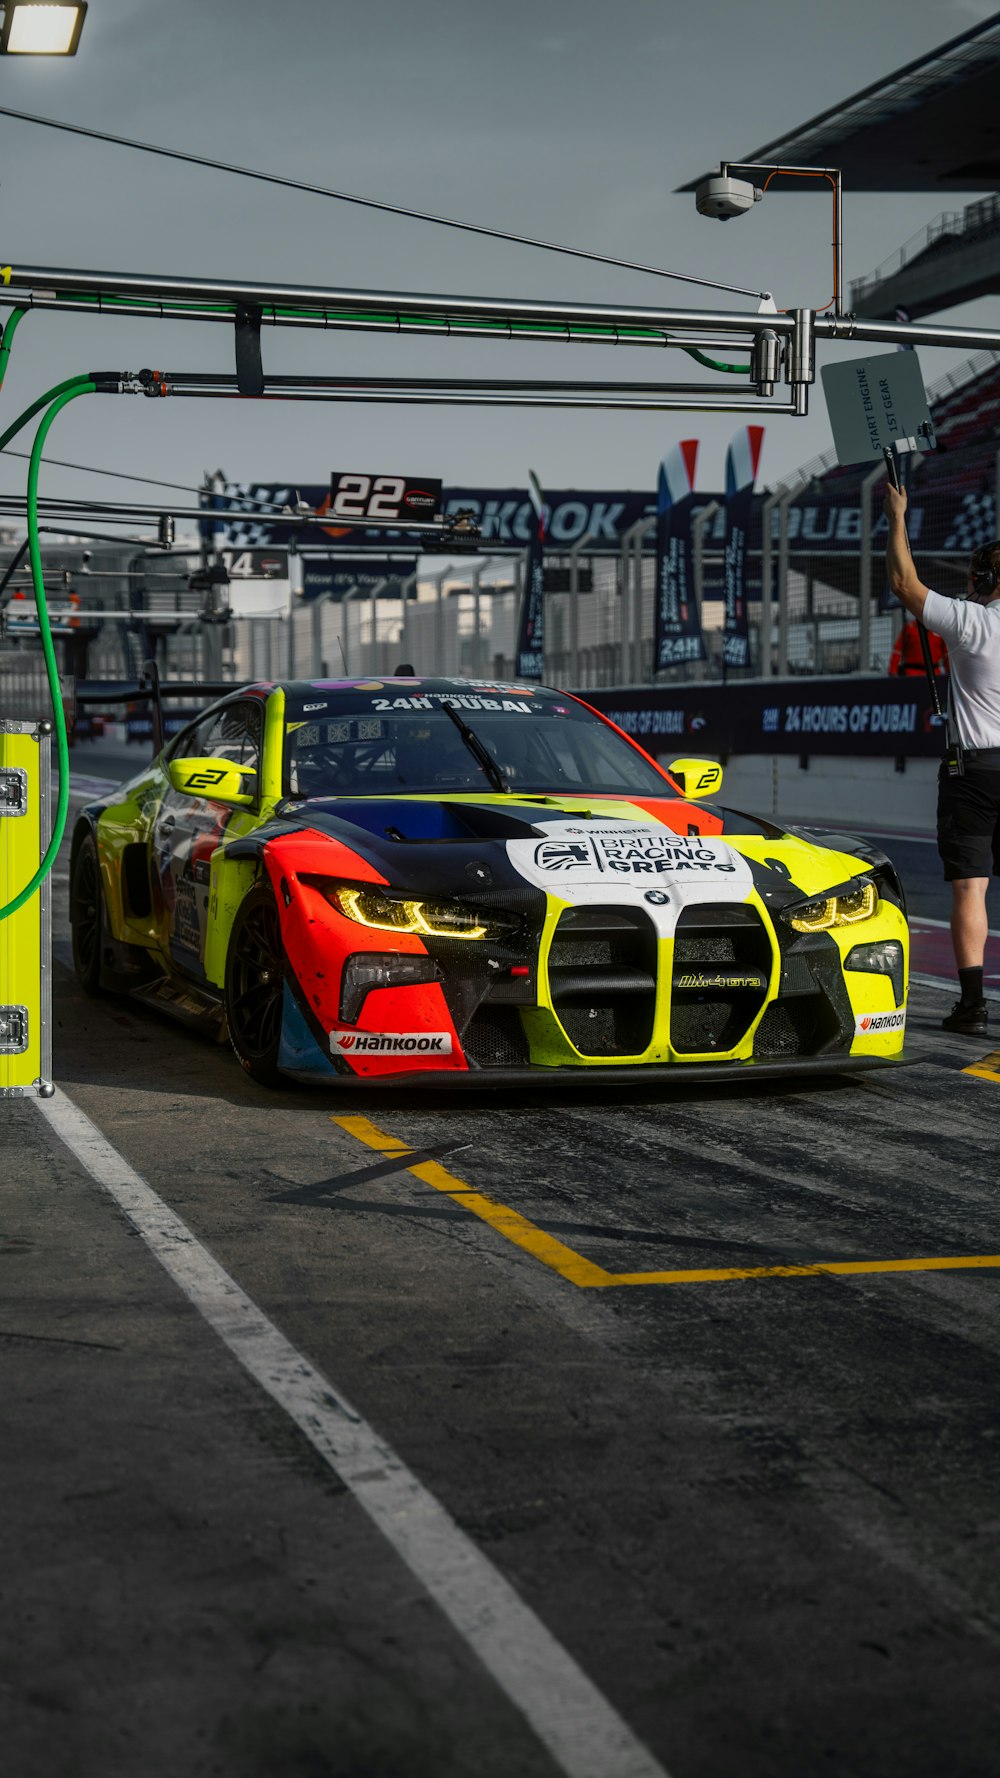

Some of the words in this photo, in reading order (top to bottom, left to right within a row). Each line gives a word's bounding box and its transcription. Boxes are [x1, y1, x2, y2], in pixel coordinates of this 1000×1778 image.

[856, 368, 873, 411] ENGINE
[879, 378, 893, 408] GEAR
[886, 413, 898, 432] 1ST
[866, 415, 882, 450] START
[333, 474, 407, 518] 22
[661, 637, 698, 652] 24H
[371, 697, 433, 711] 24H
[439, 697, 532, 713] DUBAI
[652, 710, 685, 734] DUBAI
[784, 706, 801, 732] 24
[802, 704, 848, 732] HOURS
[849, 704, 870, 732] OF
[870, 703, 918, 732] DUBAI
[586, 827, 652, 835] WINHERE
[600, 837, 703, 848] BRITISH
[603, 848, 716, 861] RACING
[608, 859, 737, 873] GREATS
